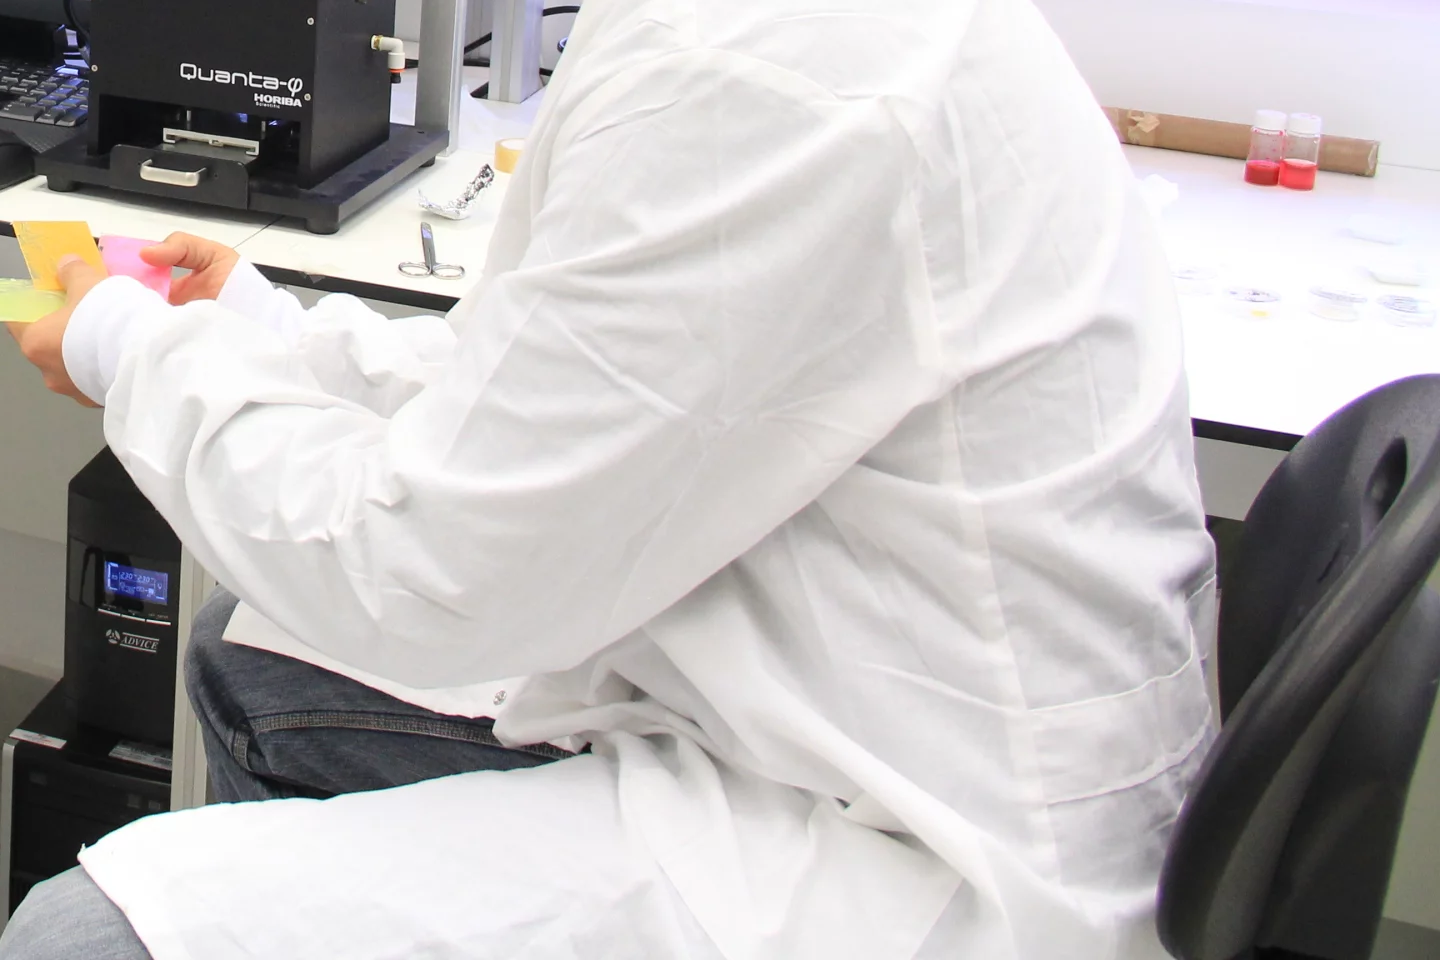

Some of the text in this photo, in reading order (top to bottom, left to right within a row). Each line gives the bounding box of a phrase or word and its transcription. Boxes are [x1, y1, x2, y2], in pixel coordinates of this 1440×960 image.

[254, 93, 302, 108] HORIBA
[255, 101, 281, 109] Scientific
[121, 636, 159, 650] ADVICE
